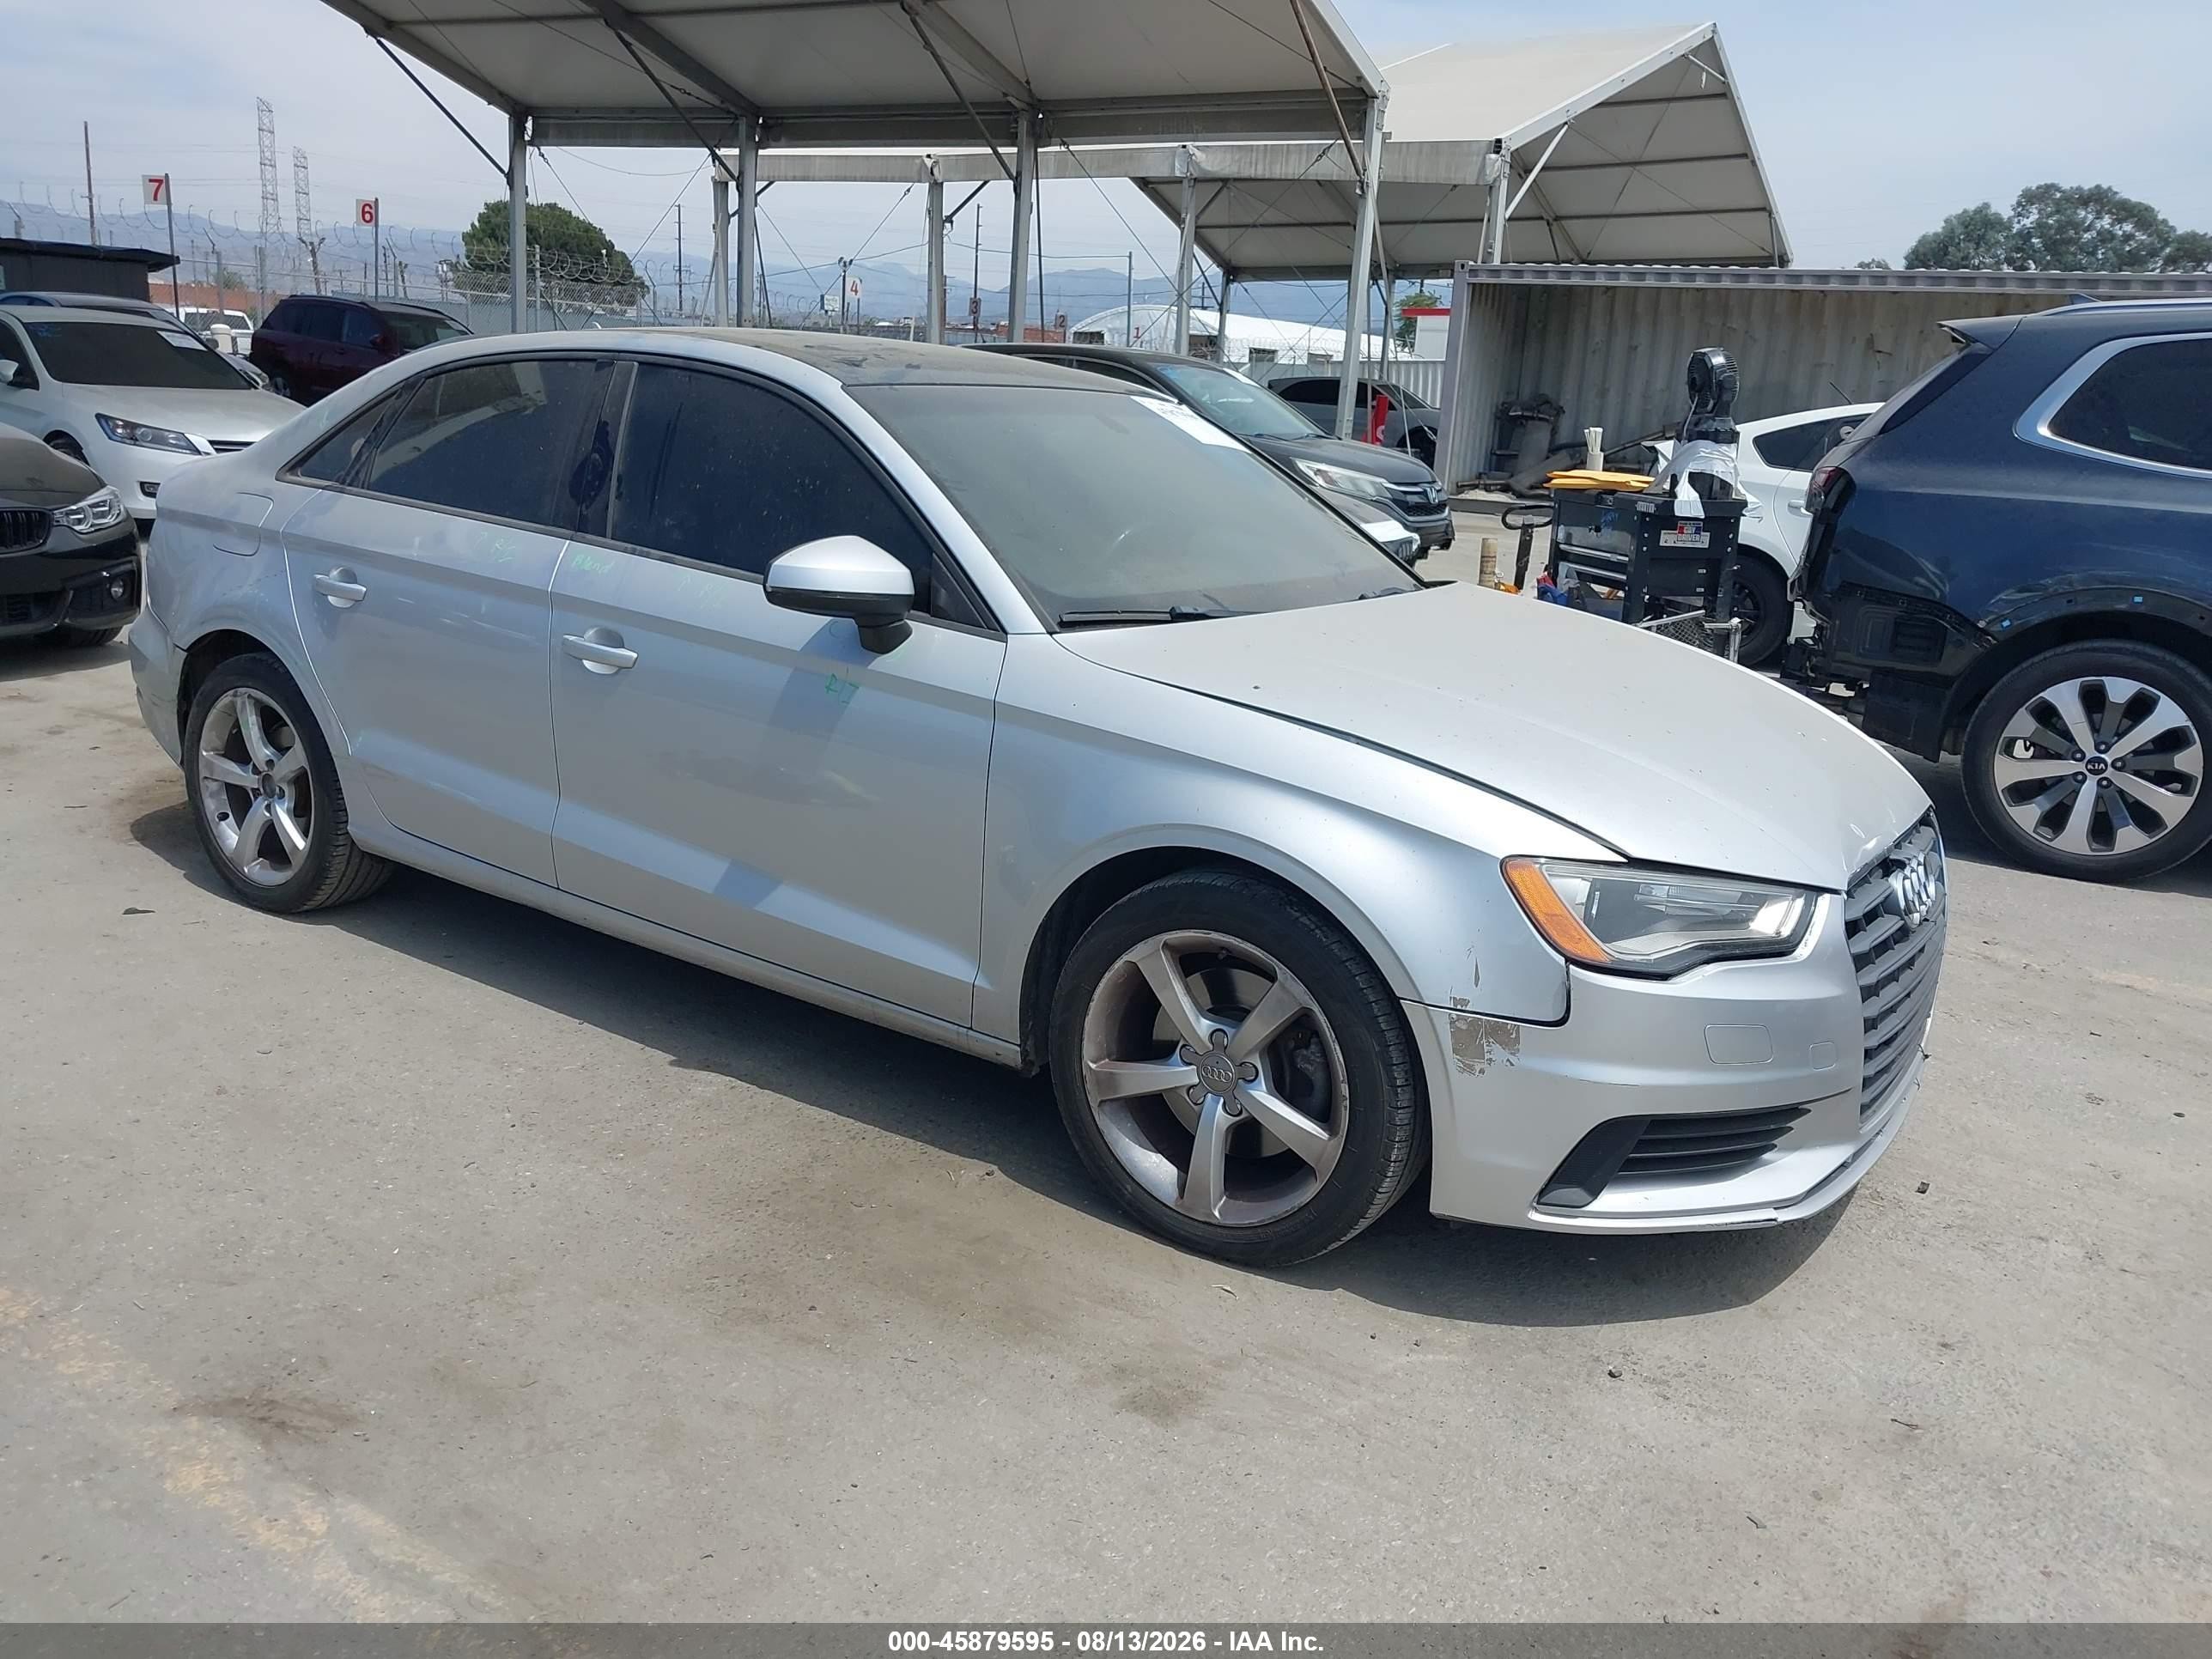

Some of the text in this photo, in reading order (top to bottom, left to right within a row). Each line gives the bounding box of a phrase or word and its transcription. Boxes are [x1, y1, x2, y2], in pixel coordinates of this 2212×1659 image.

[149, 179, 164, 202] 7
[361, 203, 374, 223] 6
[850, 280, 859, 295] 4
[971, 300, 978, 314] 3
[1059, 314, 1066, 327] 2
[1133, 326, 1141, 338] 1
